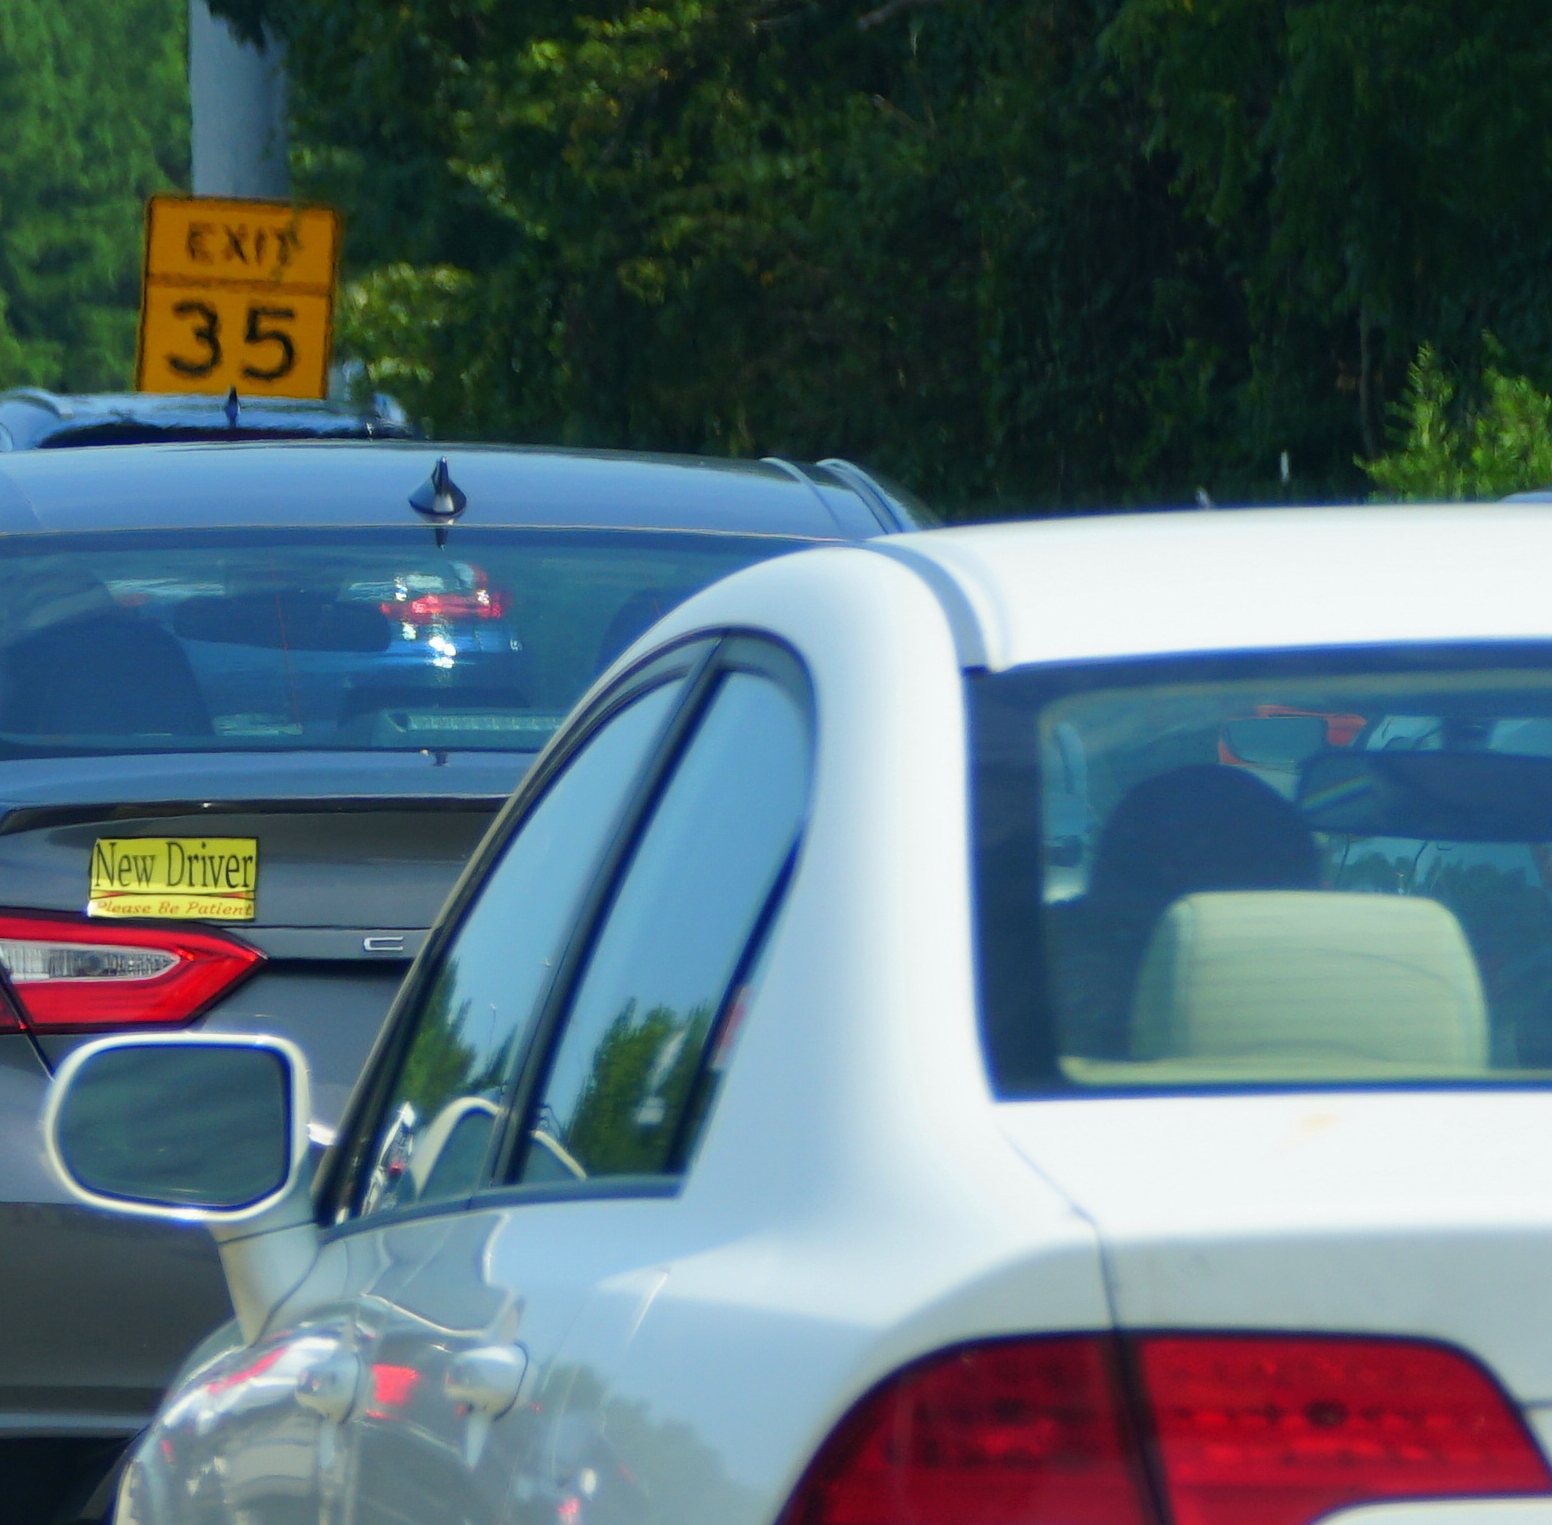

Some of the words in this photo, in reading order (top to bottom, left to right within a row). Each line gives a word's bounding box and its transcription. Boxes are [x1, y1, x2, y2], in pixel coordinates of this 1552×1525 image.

[186, 220, 296, 269] EXIT
[166, 300, 297, 381] 35
[95, 841, 156, 888] New
[166, 841, 254, 889] Driver
[97, 900, 152, 915] Please
[158, 900, 180, 915] Be
[186, 901, 253, 917] Patient
